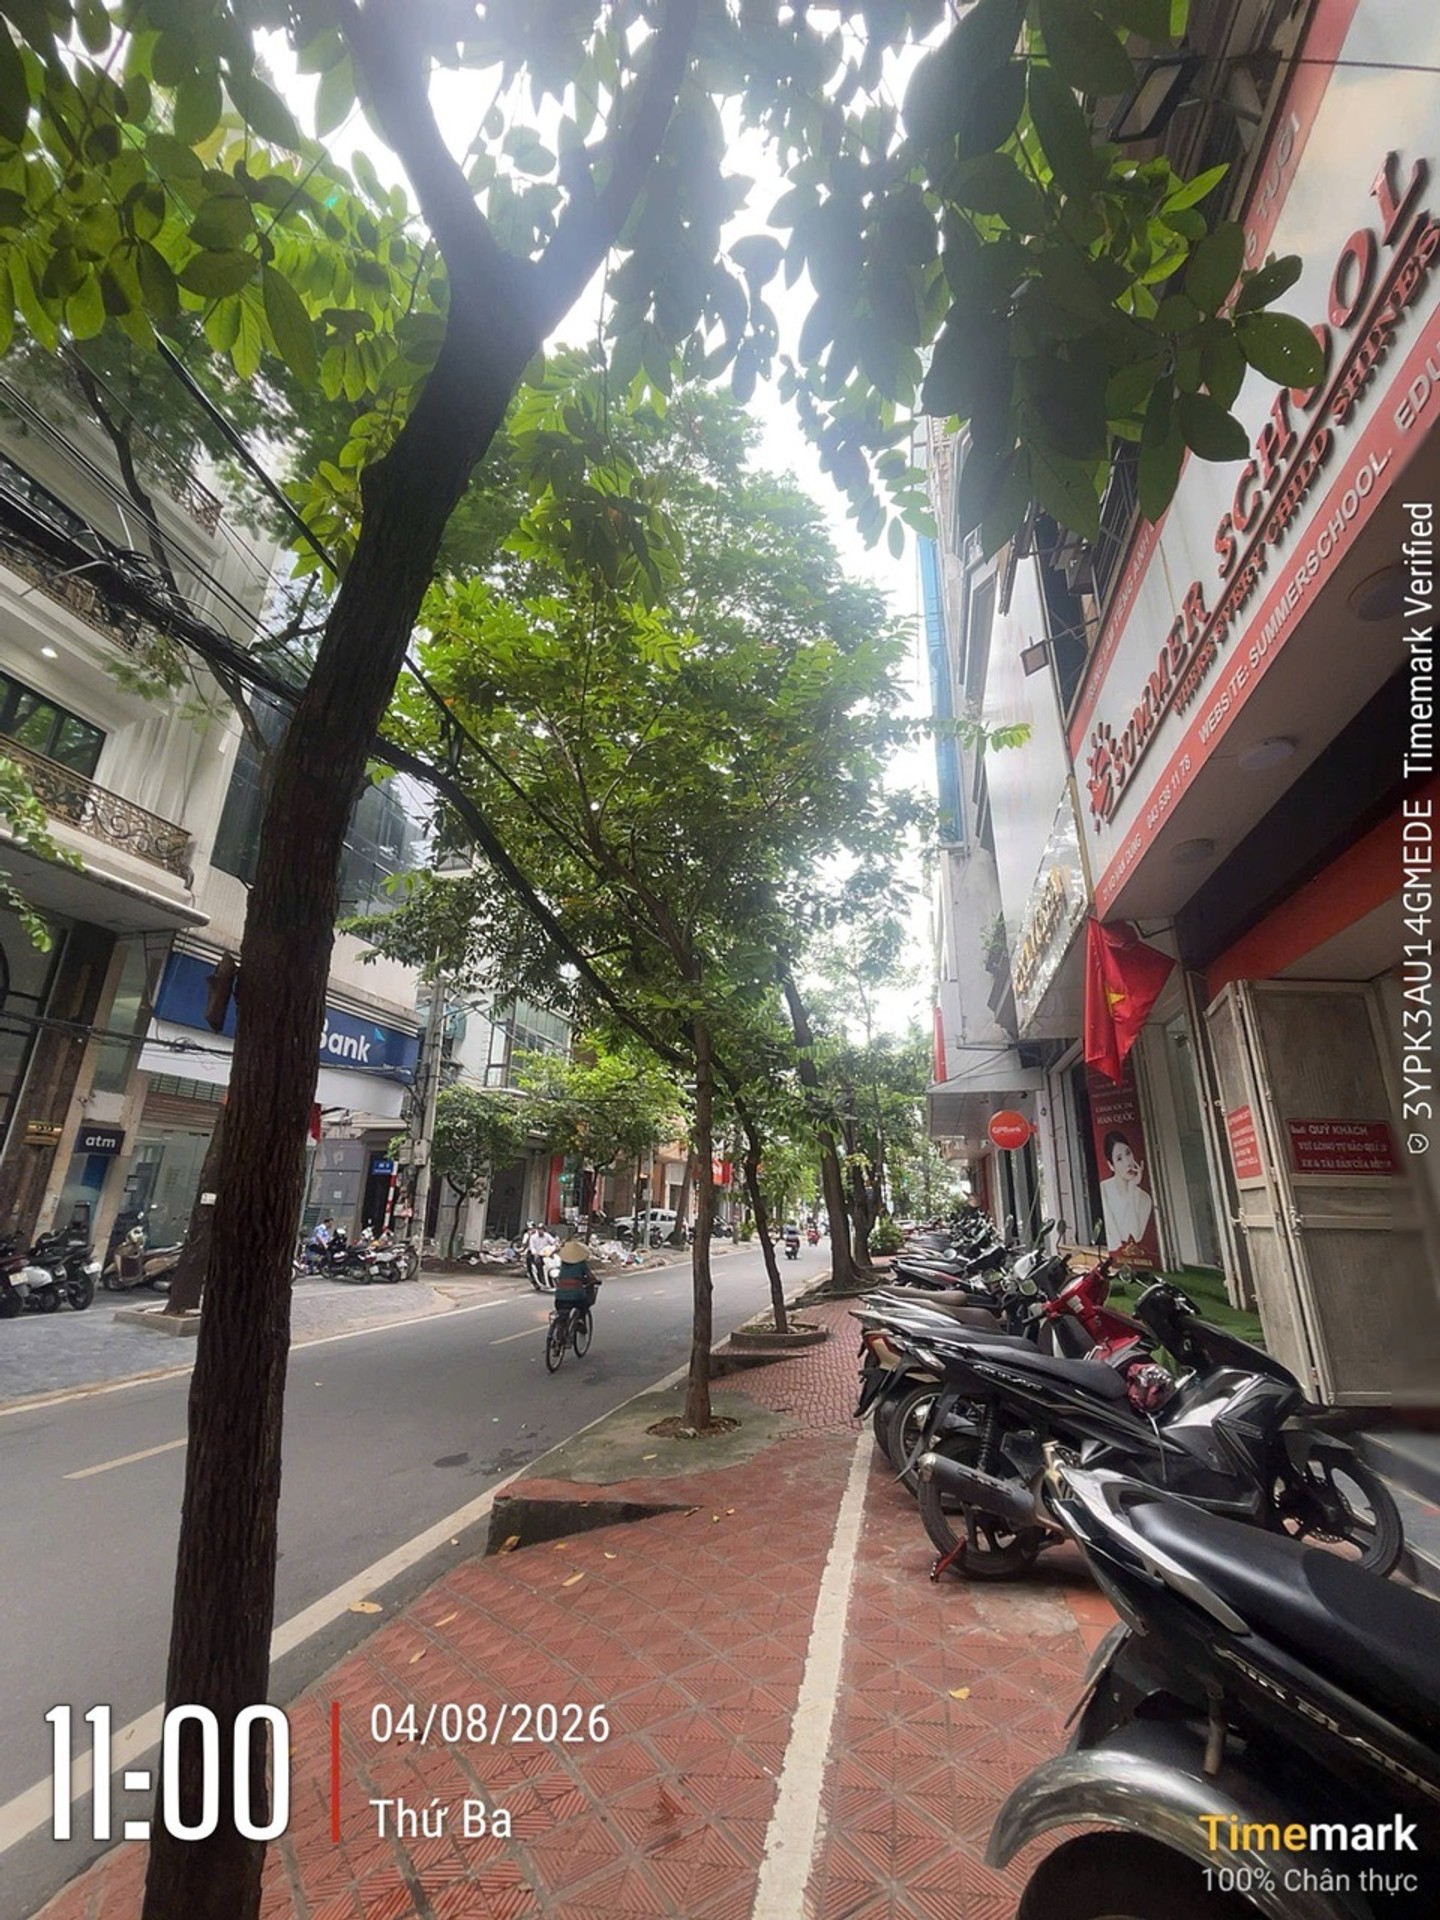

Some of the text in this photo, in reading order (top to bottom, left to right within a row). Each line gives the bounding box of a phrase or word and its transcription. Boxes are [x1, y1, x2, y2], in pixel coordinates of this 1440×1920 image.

[1266, 427, 1334, 546] CHILD
[1113, 579, 1212, 788] SUMMER
[1197, 663, 1251, 746] WEBSITE:
[85, 1135, 116, 1149] atm
